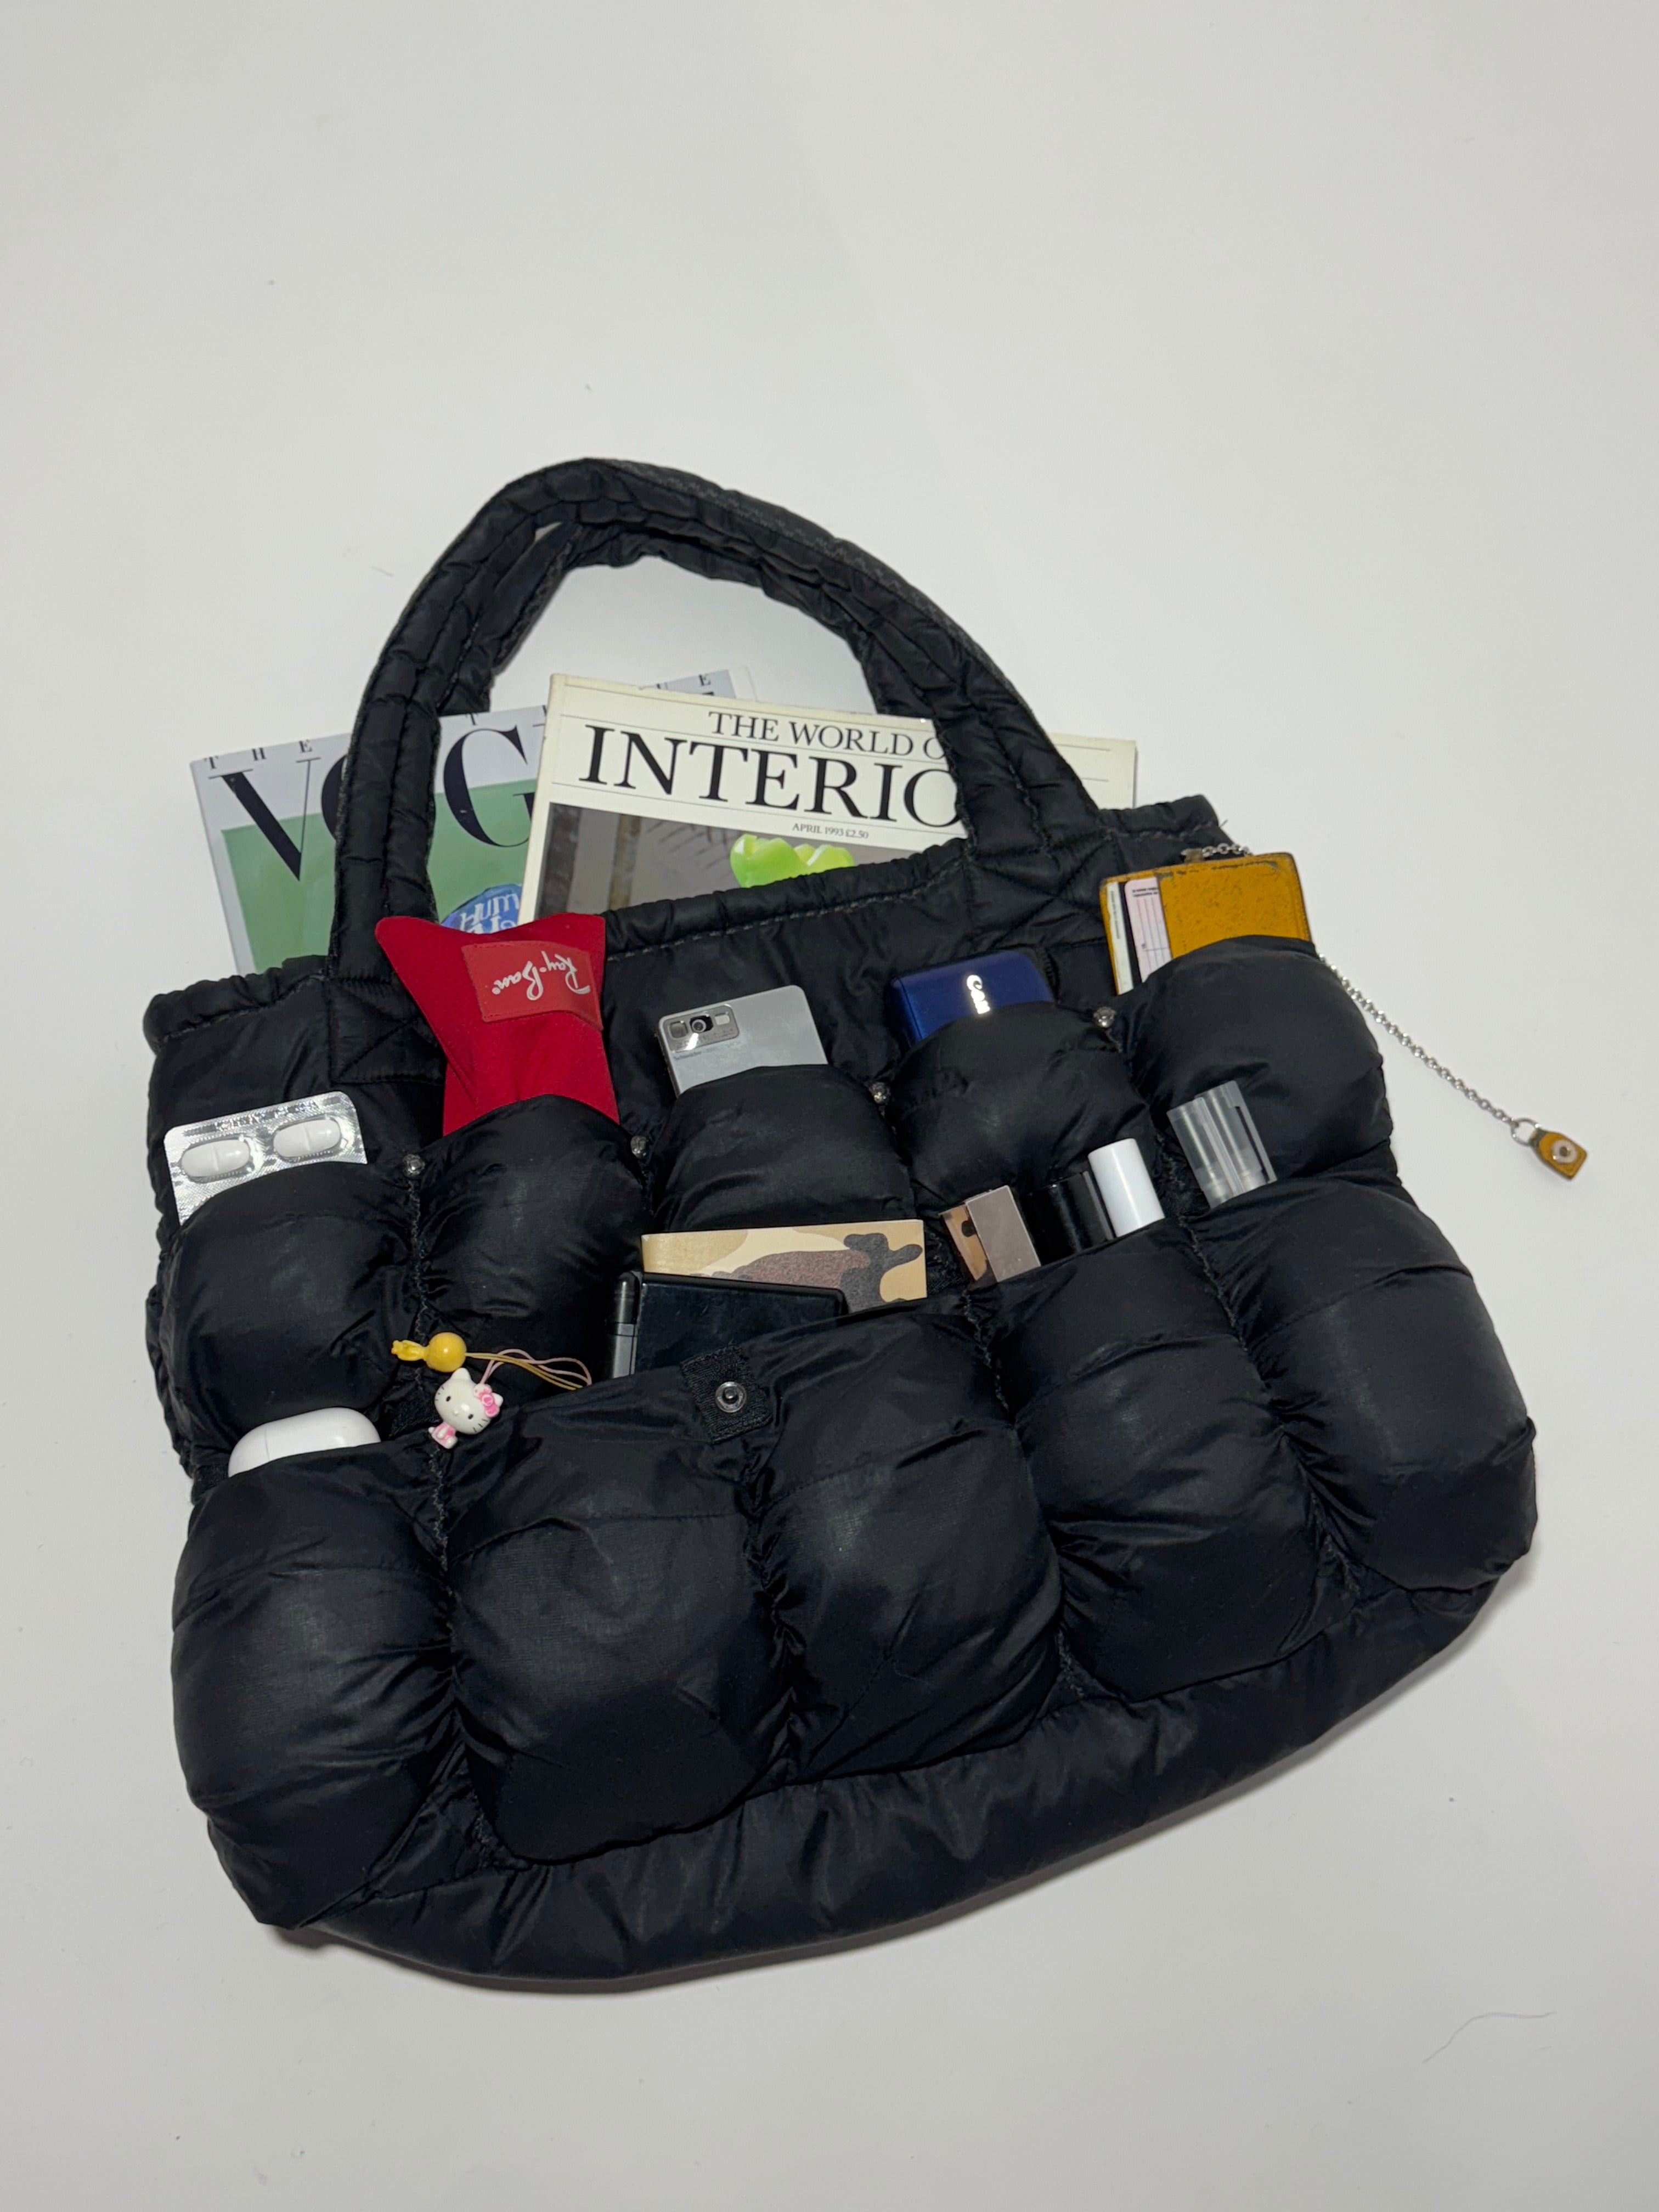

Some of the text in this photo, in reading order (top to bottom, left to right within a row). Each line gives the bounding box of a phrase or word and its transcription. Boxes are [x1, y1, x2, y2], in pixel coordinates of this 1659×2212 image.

[709, 711, 945, 760] THE WORLD O
[578, 725, 960, 827] INTERIO
[792, 823, 869, 839] APRIL 1993 £2.50
[492, 950, 591, 1001] Ray-Ban
